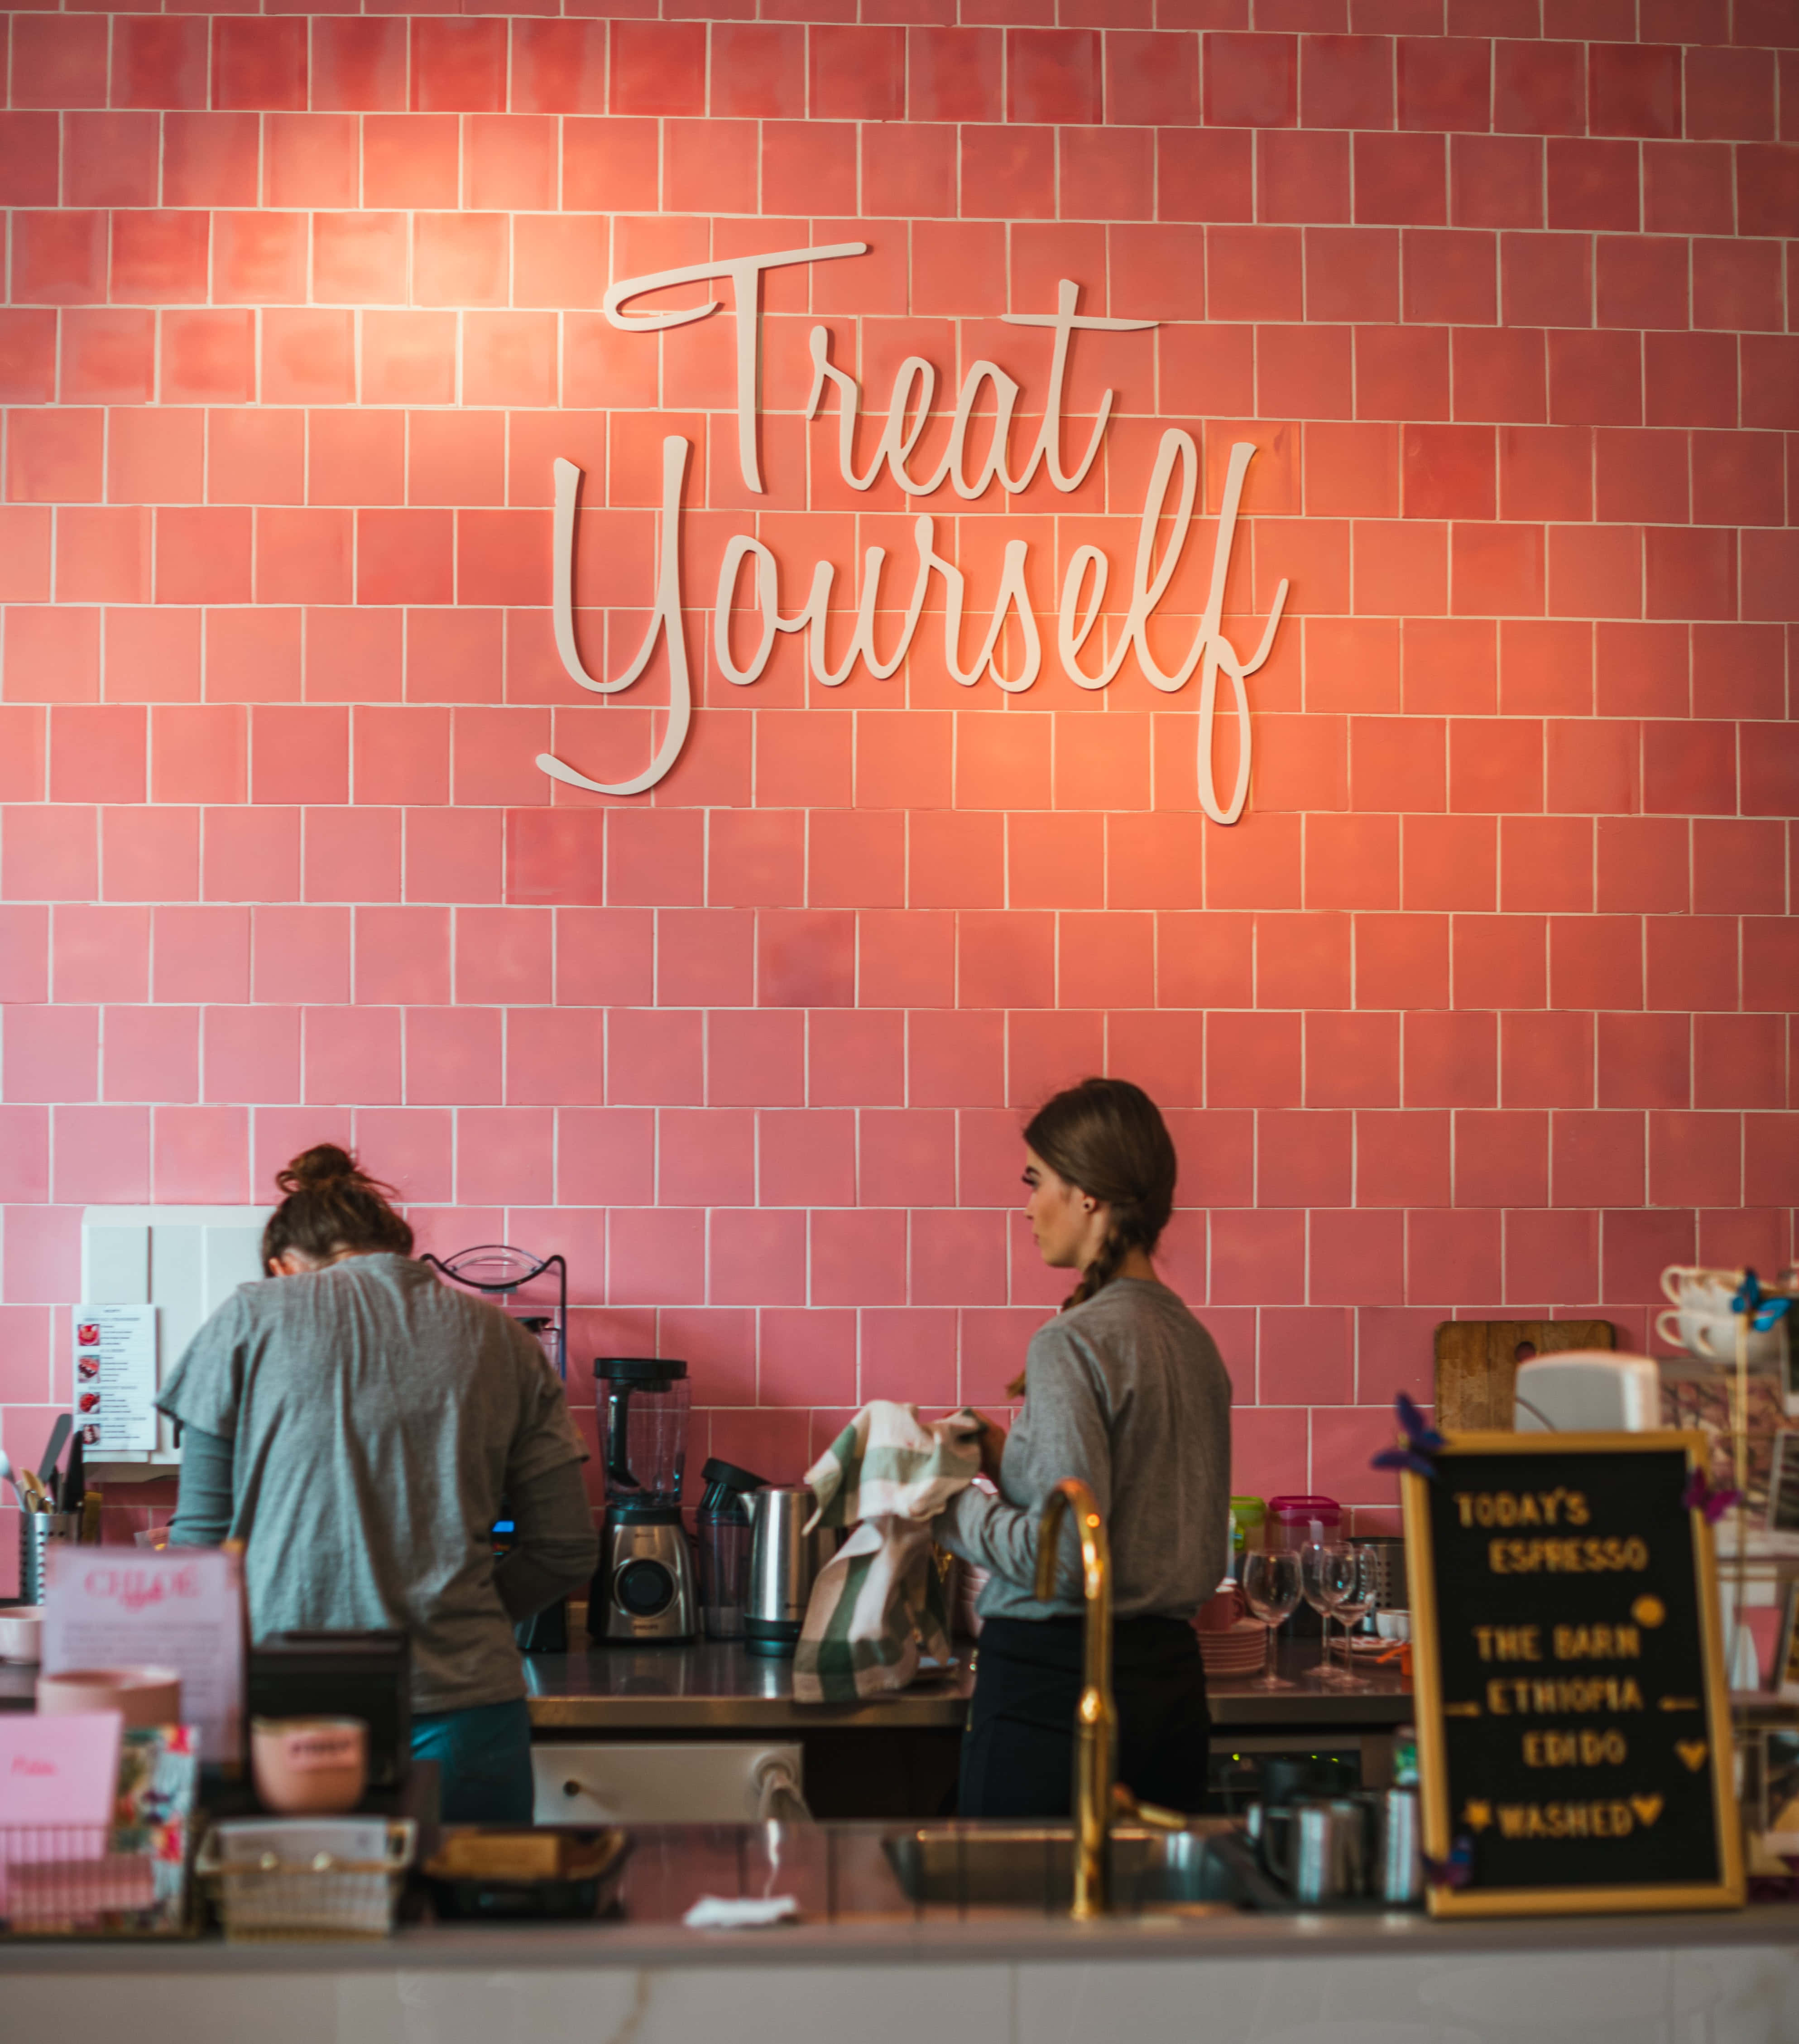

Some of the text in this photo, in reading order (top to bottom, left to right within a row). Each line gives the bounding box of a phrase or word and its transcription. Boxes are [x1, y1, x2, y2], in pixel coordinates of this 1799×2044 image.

[604, 242, 1159, 500] Treat
[535, 428, 1289, 825] Yourself
[1457, 1487, 1589, 1526] TODAY'S
[1489, 1538, 1648, 1573] ESPRESSO
[1475, 1625, 1640, 1660] THE BARN
[1487, 1678, 1642, 1714] ETHIOPIA
[1497, 1801, 1633, 1837] WASHED
